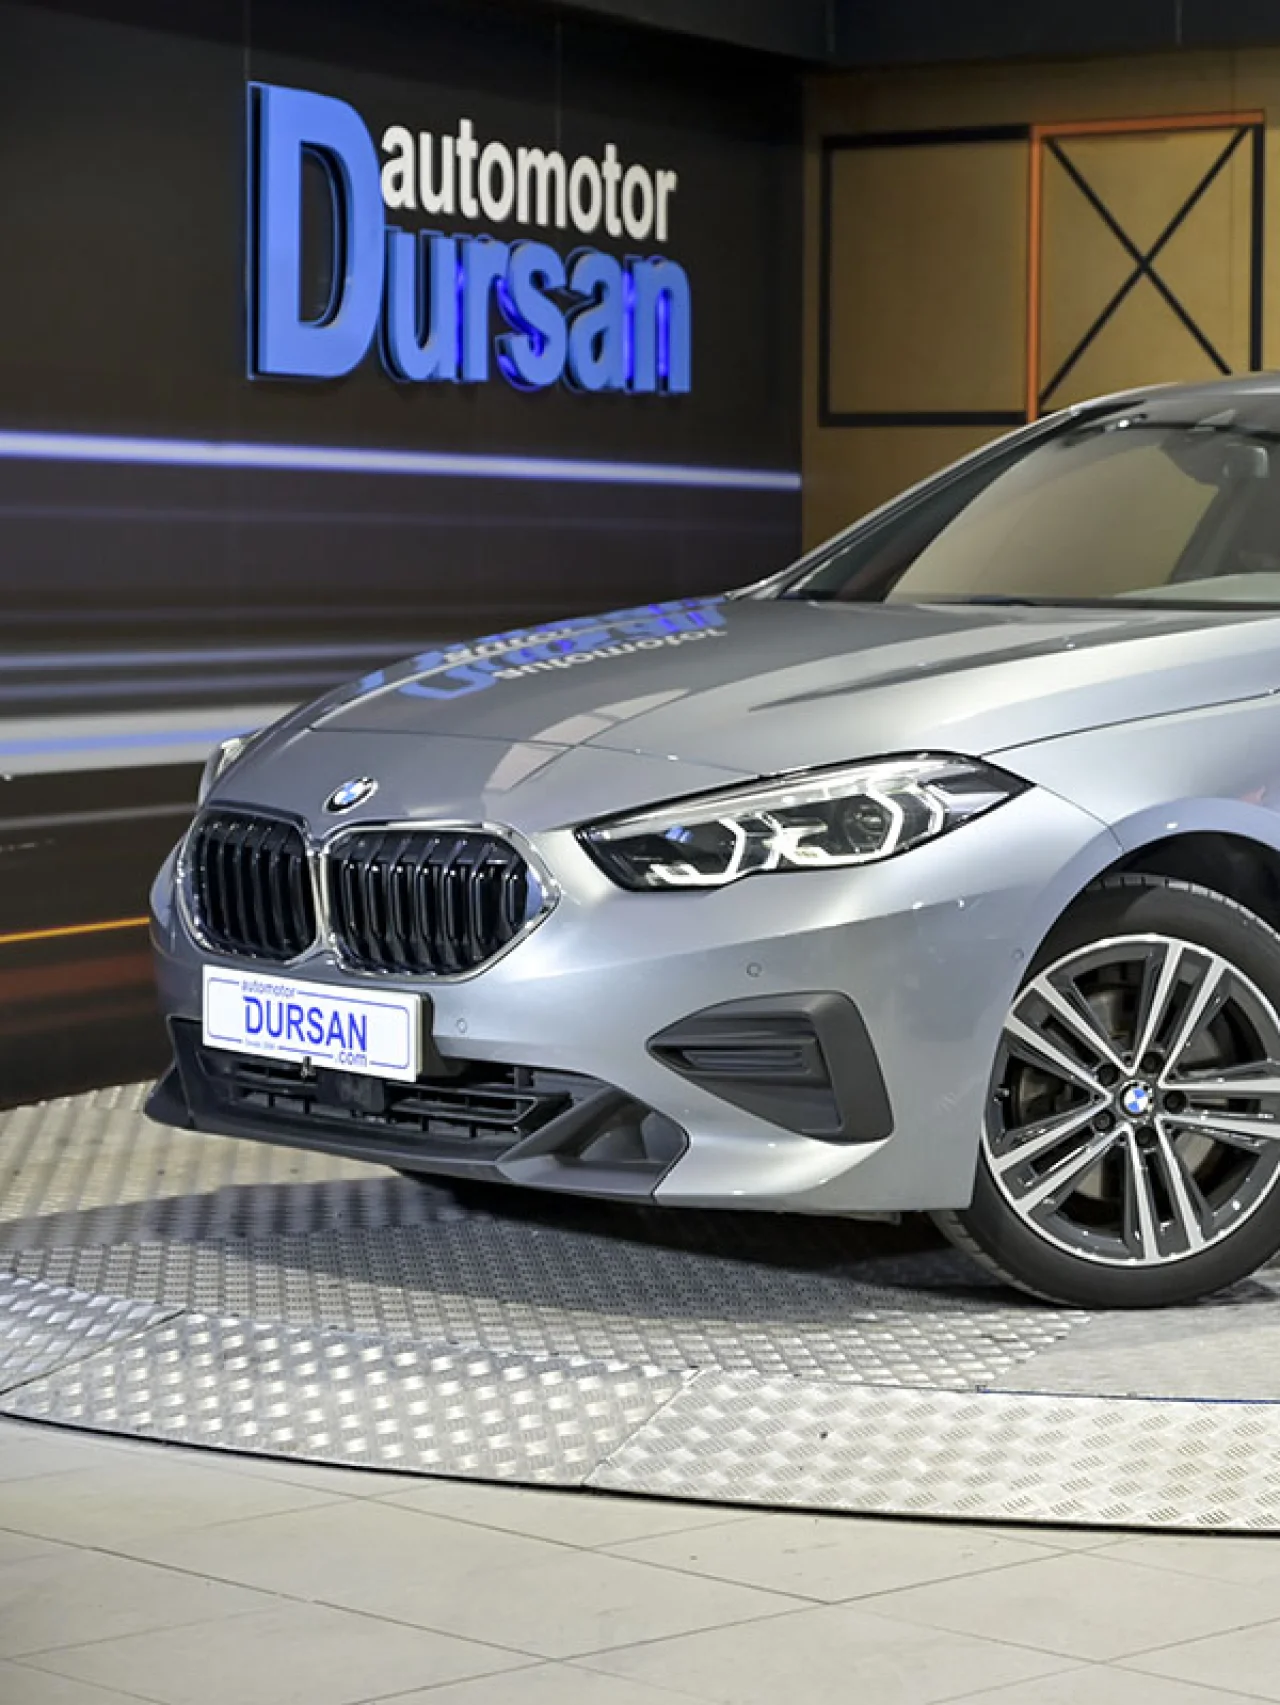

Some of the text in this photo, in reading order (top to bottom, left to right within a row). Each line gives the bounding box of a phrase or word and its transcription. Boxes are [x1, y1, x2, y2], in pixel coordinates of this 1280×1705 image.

[381, 118, 677, 242] automotor
[247, 81, 691, 394] Dursan
[241, 979, 297, 998] automotor
[243, 995, 367, 1052] DURSAN
[334, 1051, 367, 1067] .com
